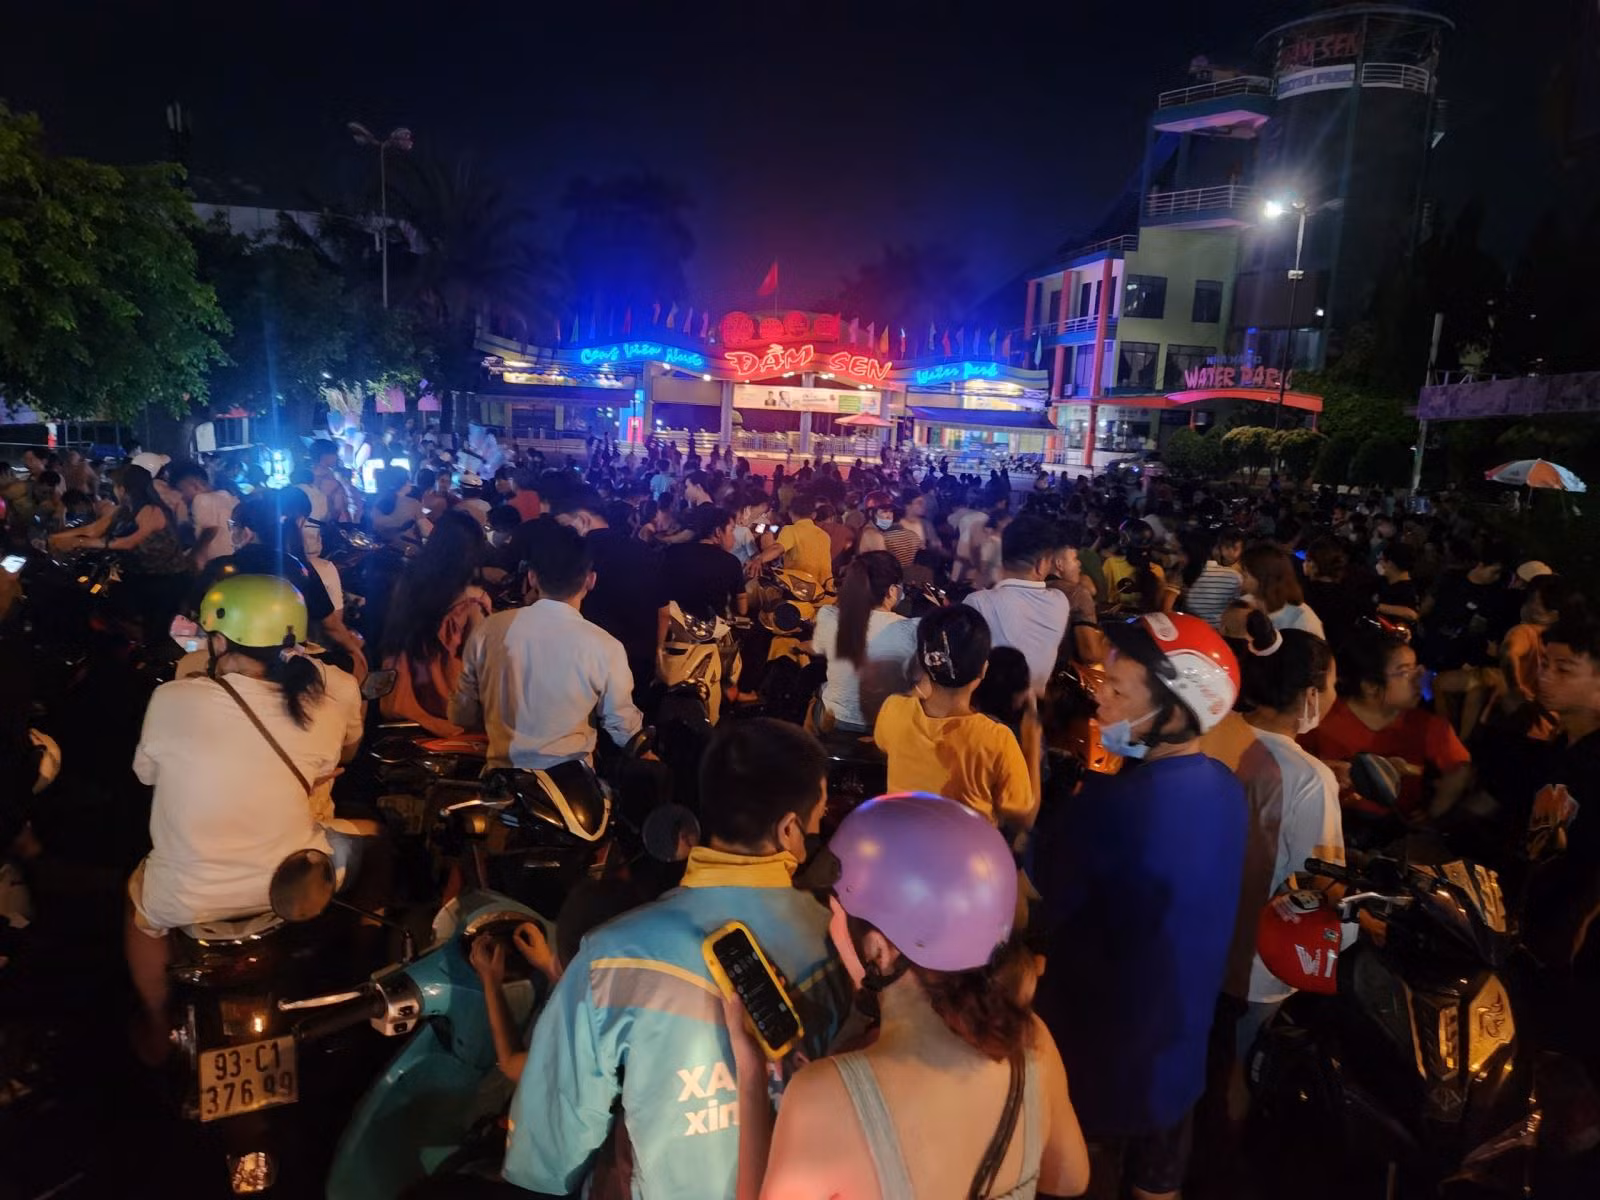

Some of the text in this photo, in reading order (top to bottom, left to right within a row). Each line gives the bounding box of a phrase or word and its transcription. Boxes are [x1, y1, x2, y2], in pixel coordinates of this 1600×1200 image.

[829, 352, 893, 382] SEN
[1184, 366, 1236, 389] WATER
[214, 1041, 281, 1081] 93-C1
